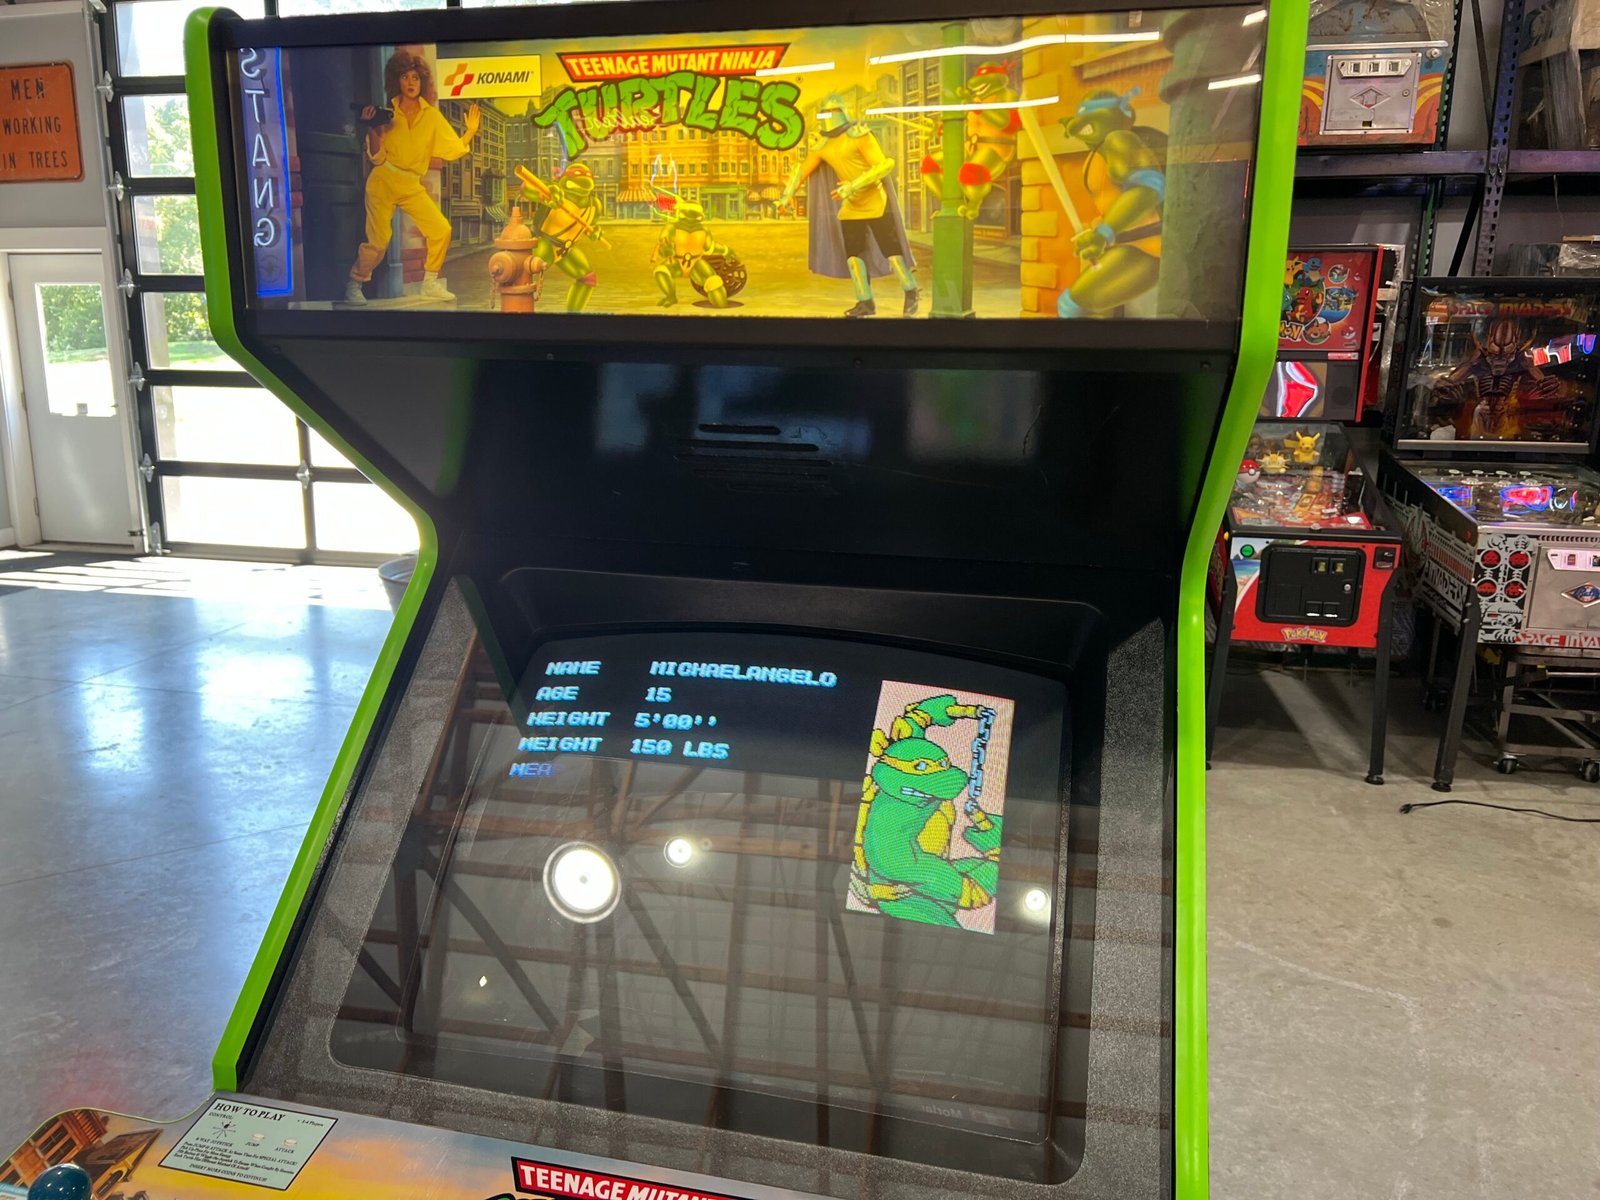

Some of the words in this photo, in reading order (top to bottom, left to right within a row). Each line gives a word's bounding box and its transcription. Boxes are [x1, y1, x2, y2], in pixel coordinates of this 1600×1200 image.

[565, 55, 650, 76] TEENAGE
[652, 52, 716, 74] MUTANT
[719, 50, 777, 71] NINJA
[476, 71, 530, 85] KONAMI
[10, 78, 45, 101] MEN
[533, 70, 806, 161] TURTLES
[3, 116, 61, 135] WORKING
[2, 151, 17, 169] IN
[29, 151, 68, 169] TREES
[1514, 633, 1561, 646] SPACE
[545, 660, 602, 677] NAME
[649, 660, 838, 689] MICHAELANGELO
[535, 686, 580, 702] AGE
[644, 686, 673, 703] 15
[526, 711, 612, 728] HEIGHT
[629, 738, 673, 756] 150
[682, 740, 731, 760] LBS
[214, 1103, 243, 1113] HOW
[242, 1107, 258, 1117] TO
[257, 1110, 286, 1121] PLAY
[520, 1164, 626, 1200] TEENAGE
